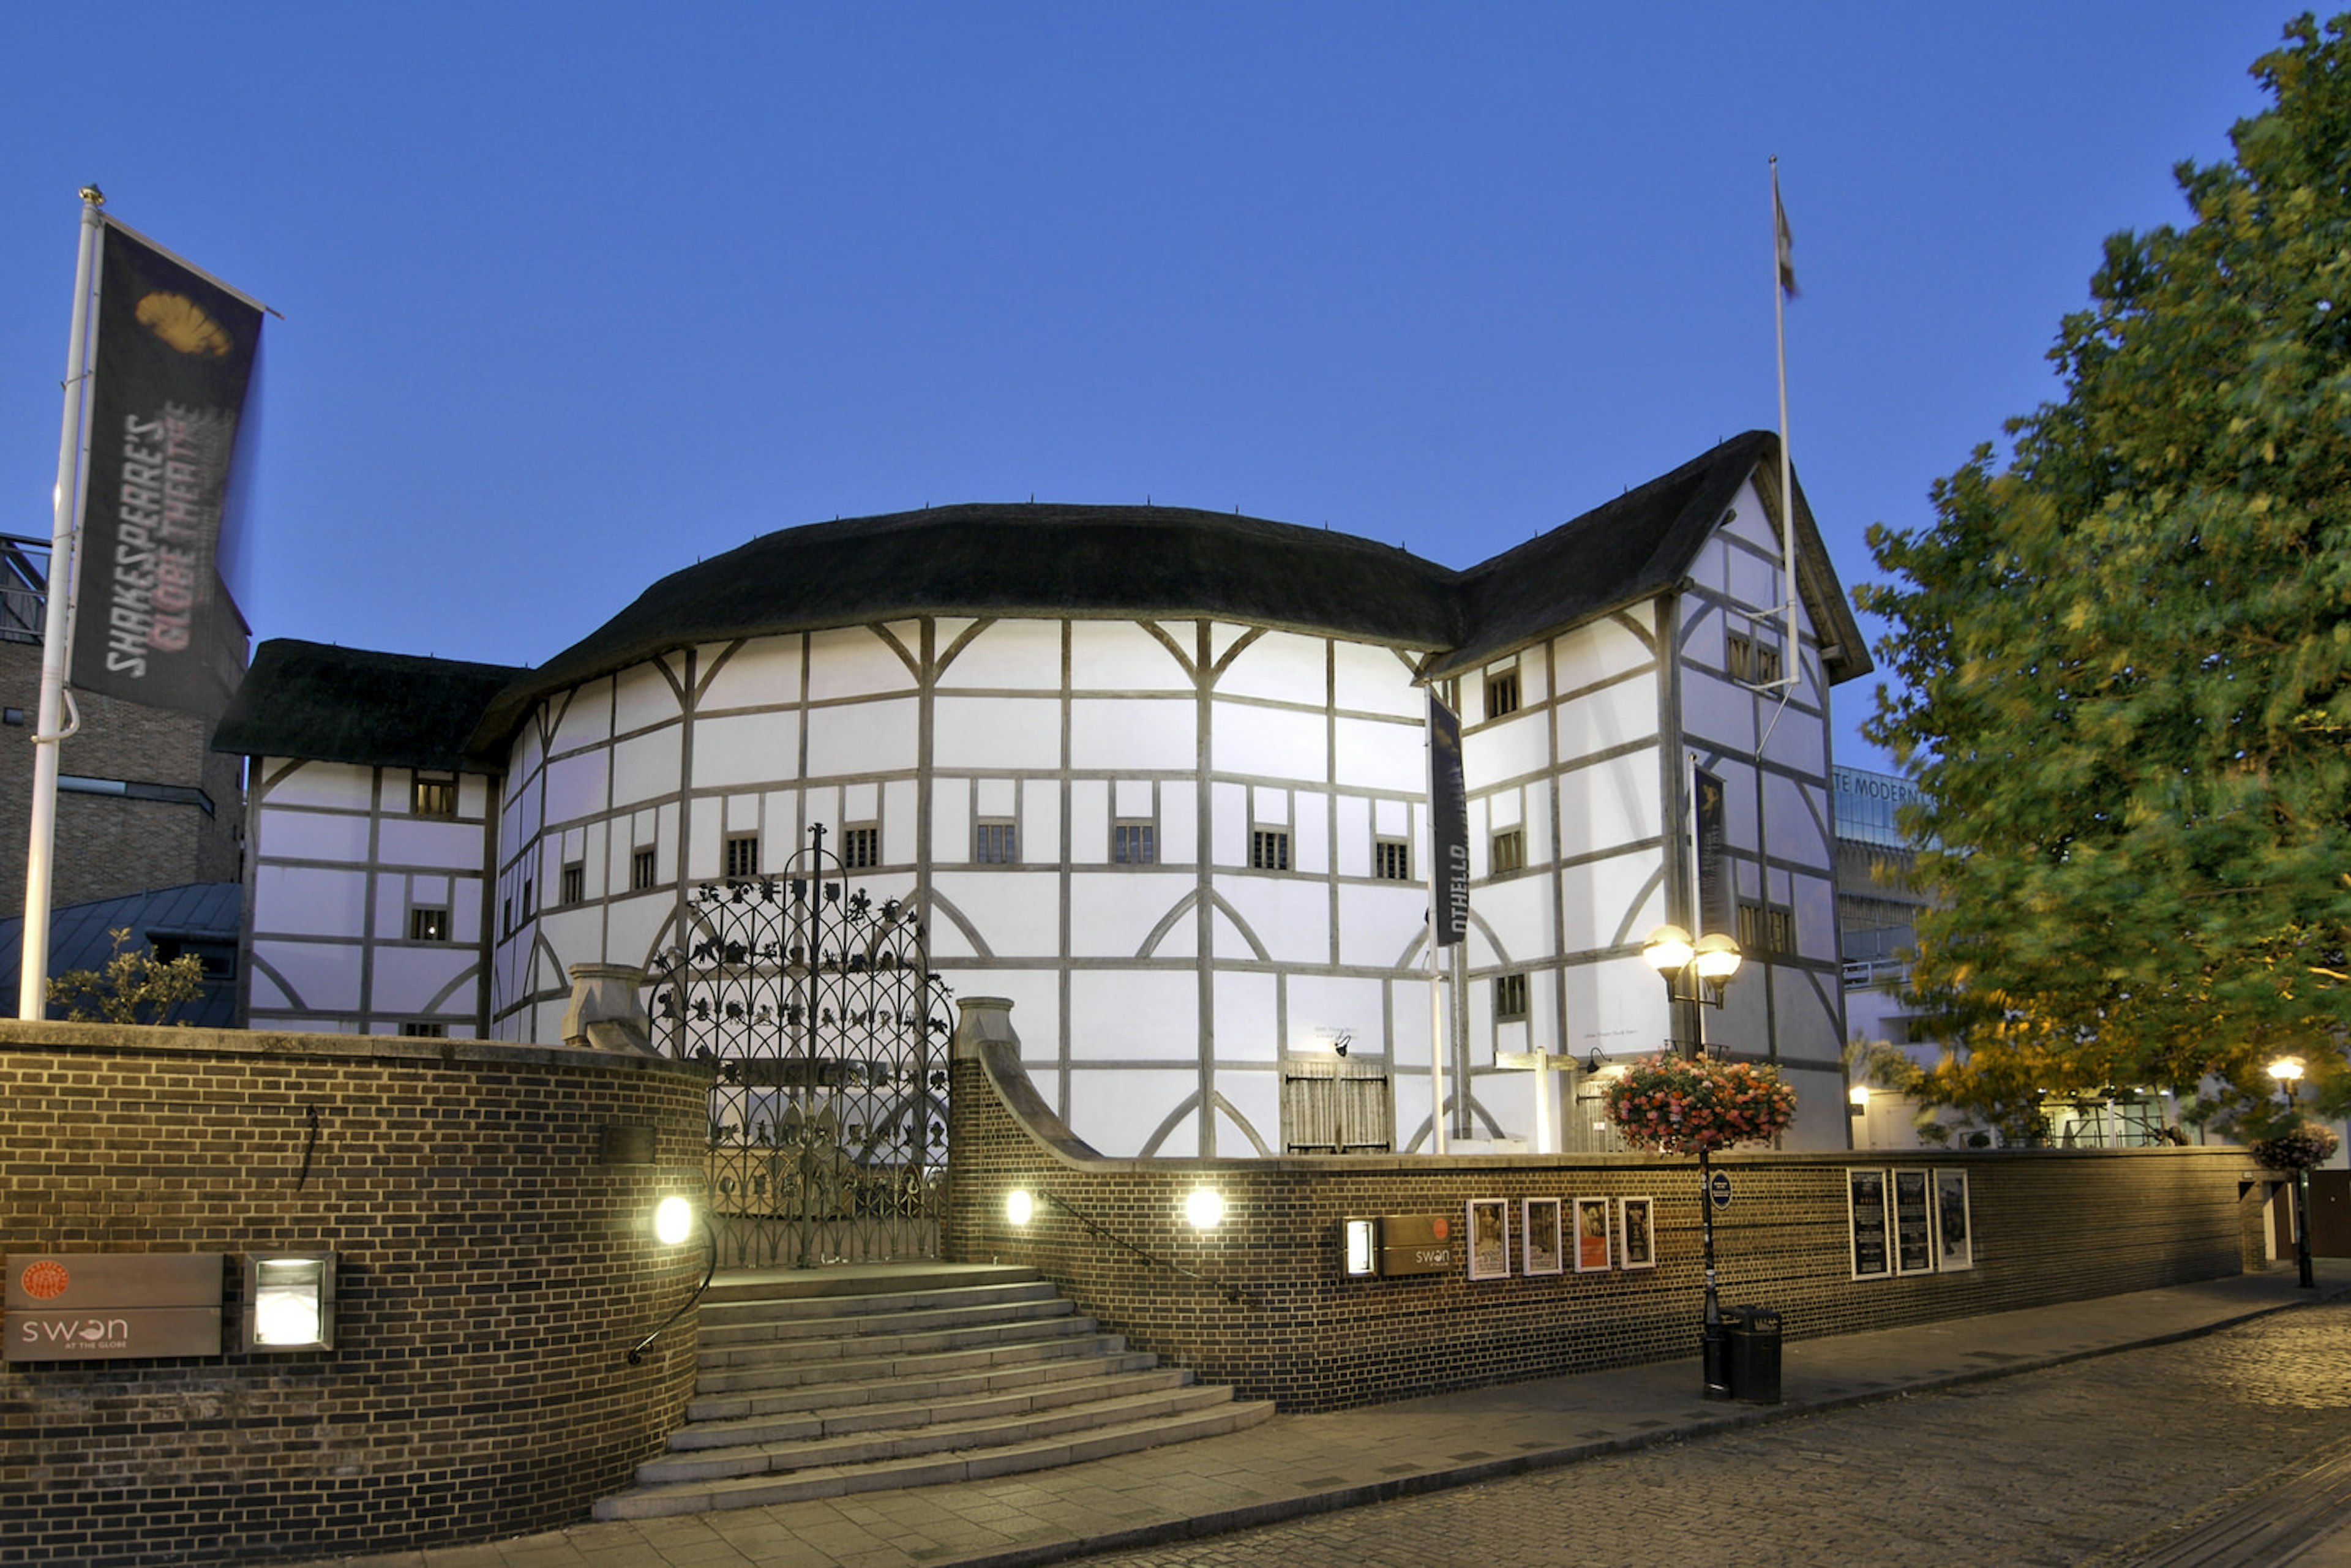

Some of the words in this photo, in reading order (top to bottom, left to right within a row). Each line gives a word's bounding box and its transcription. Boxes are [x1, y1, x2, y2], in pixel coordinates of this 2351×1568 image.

[106, 414, 165, 678] SHAKESPEARE'S
[146, 544, 195, 652] GLOBE
[1856, 776, 1918, 803] MODERN
[1449, 844, 1468, 933] OTHELLO
[1415, 1250, 1450, 1263] swan
[22, 1319, 128, 1342] swan
